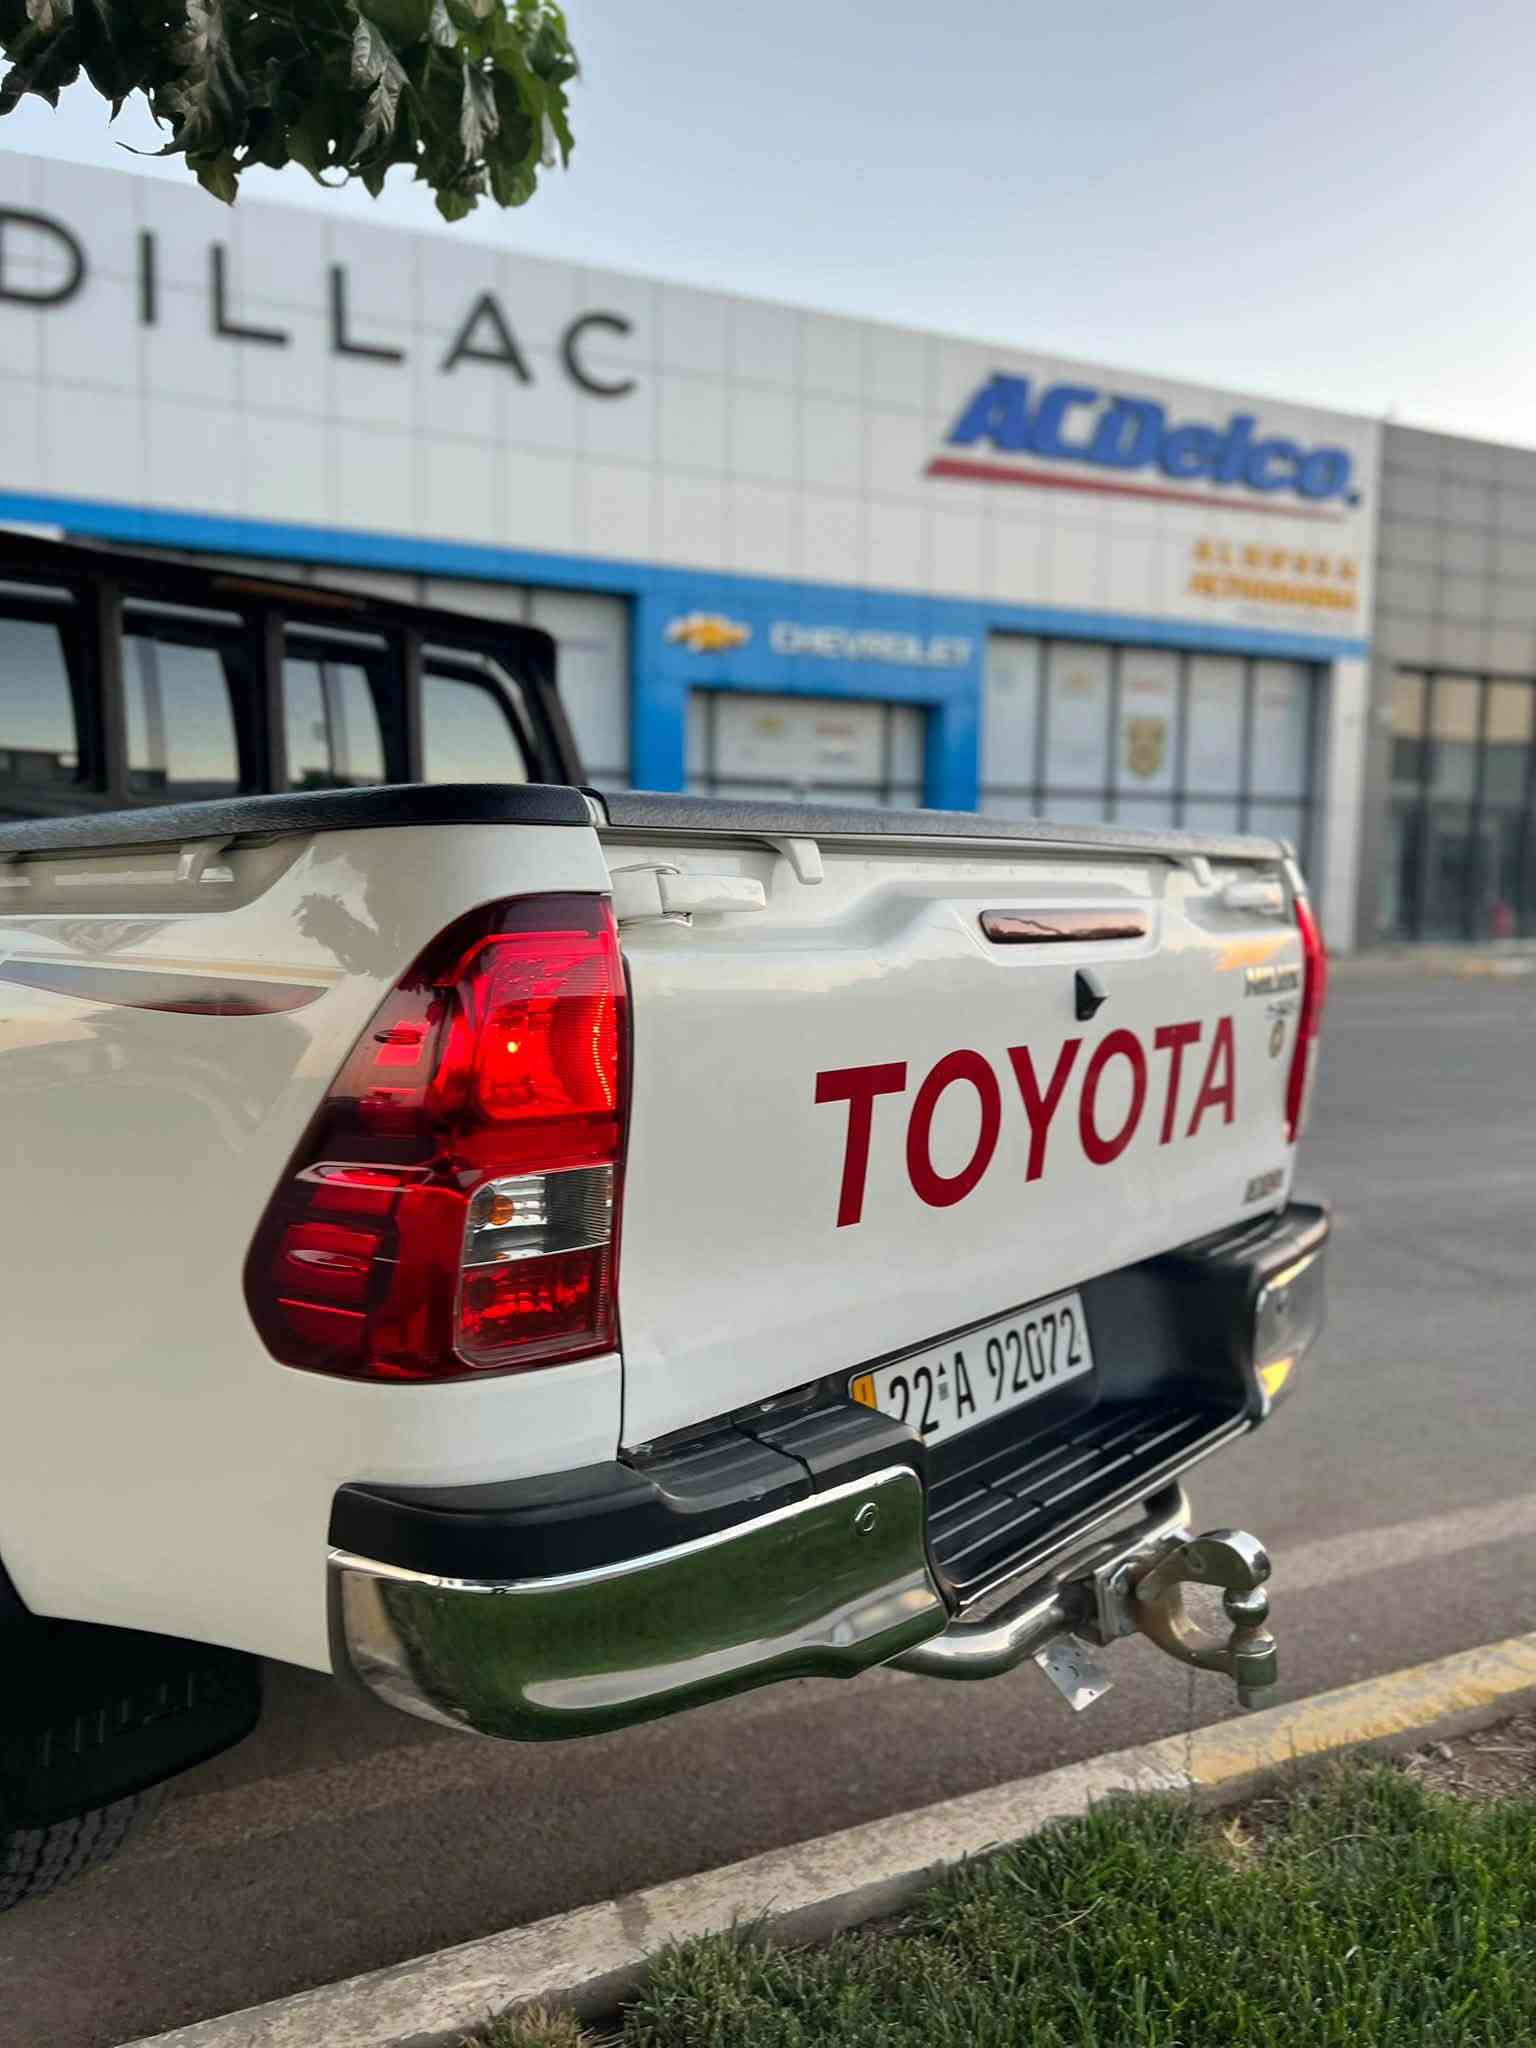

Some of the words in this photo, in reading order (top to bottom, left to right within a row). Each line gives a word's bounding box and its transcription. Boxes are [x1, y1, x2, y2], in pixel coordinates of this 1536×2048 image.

[814, 1016, 1236, 1228] TOYOTA
[889, 1366, 939, 1436] 22
[954, 1351, 976, 1419] A
[986, 1307, 1081, 1402] 92072
